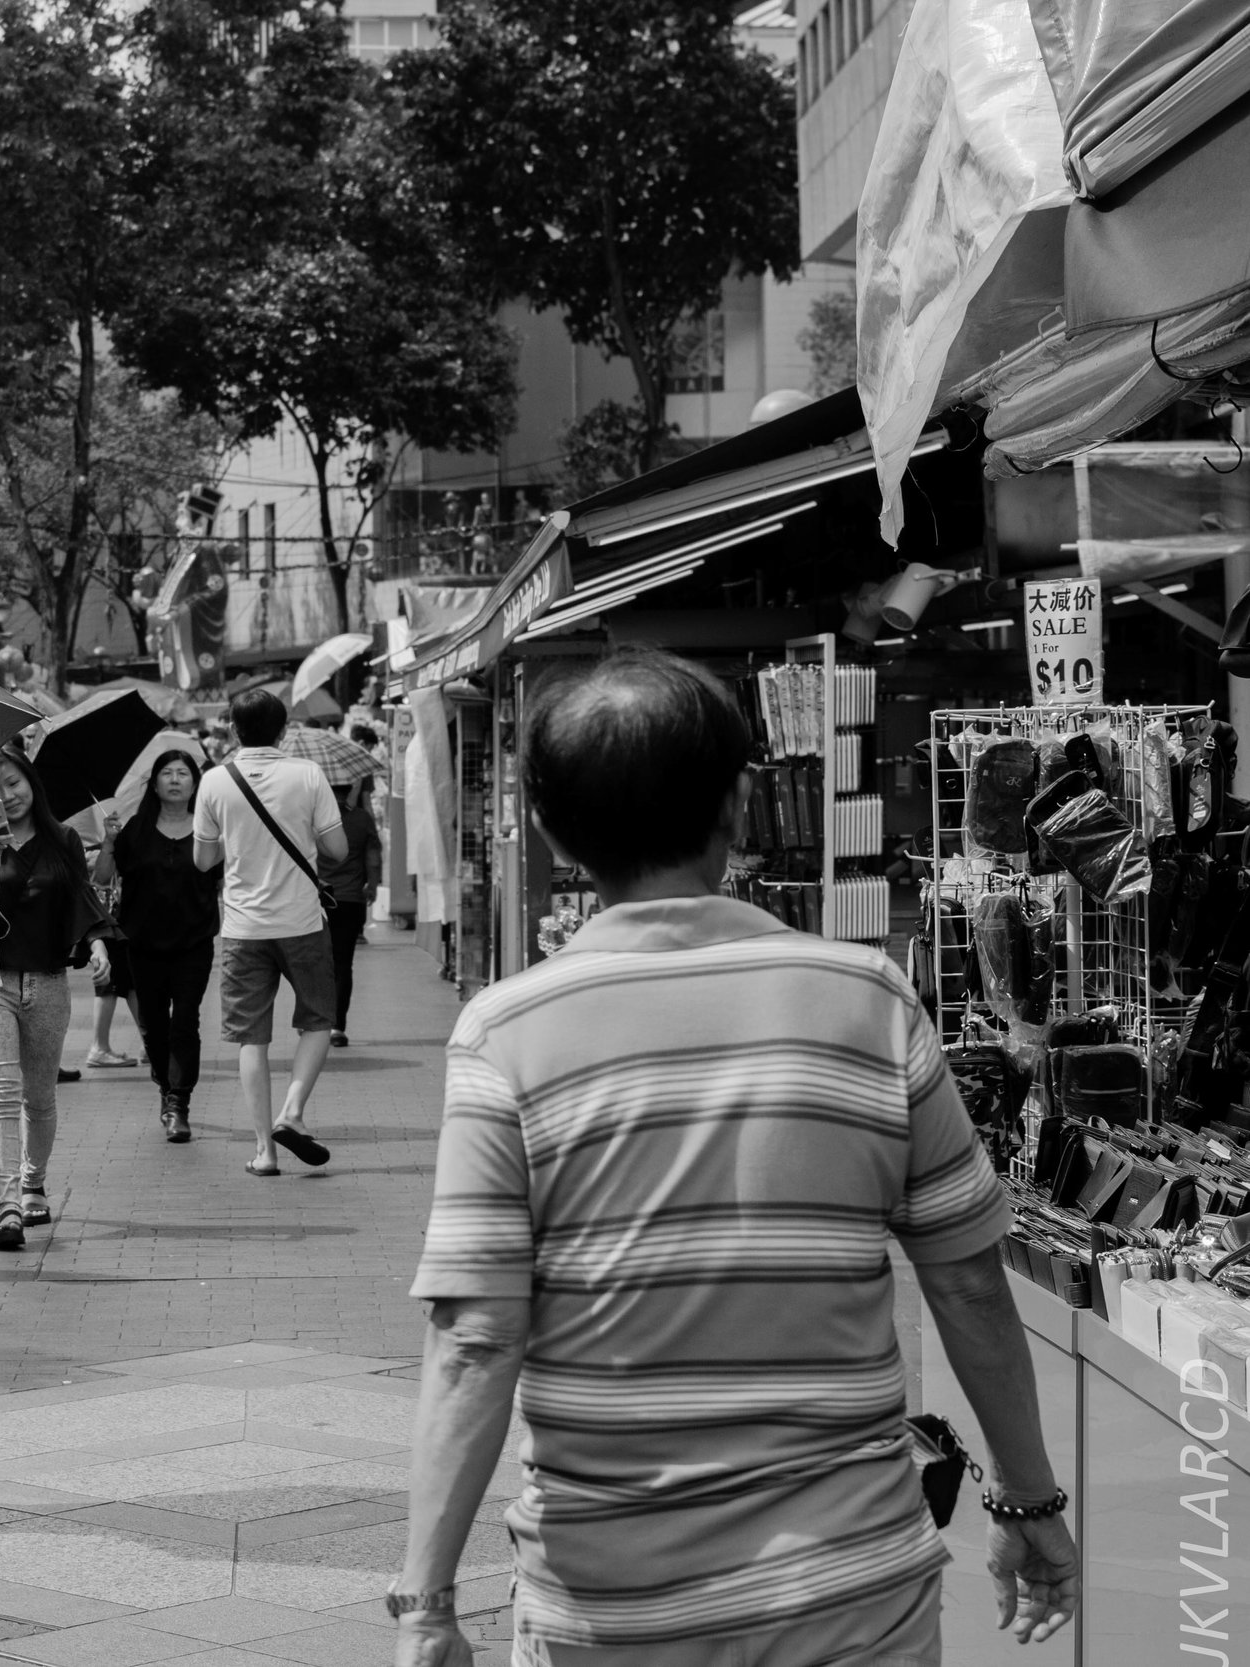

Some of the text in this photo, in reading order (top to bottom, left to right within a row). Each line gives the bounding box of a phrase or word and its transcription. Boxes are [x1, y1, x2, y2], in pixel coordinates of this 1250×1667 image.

[1029, 585, 1096, 613] 大减价
[1032, 617, 1087, 637] SALE
[1033, 643, 1059, 654] 1 For
[1036, 658, 1094, 697] $10
